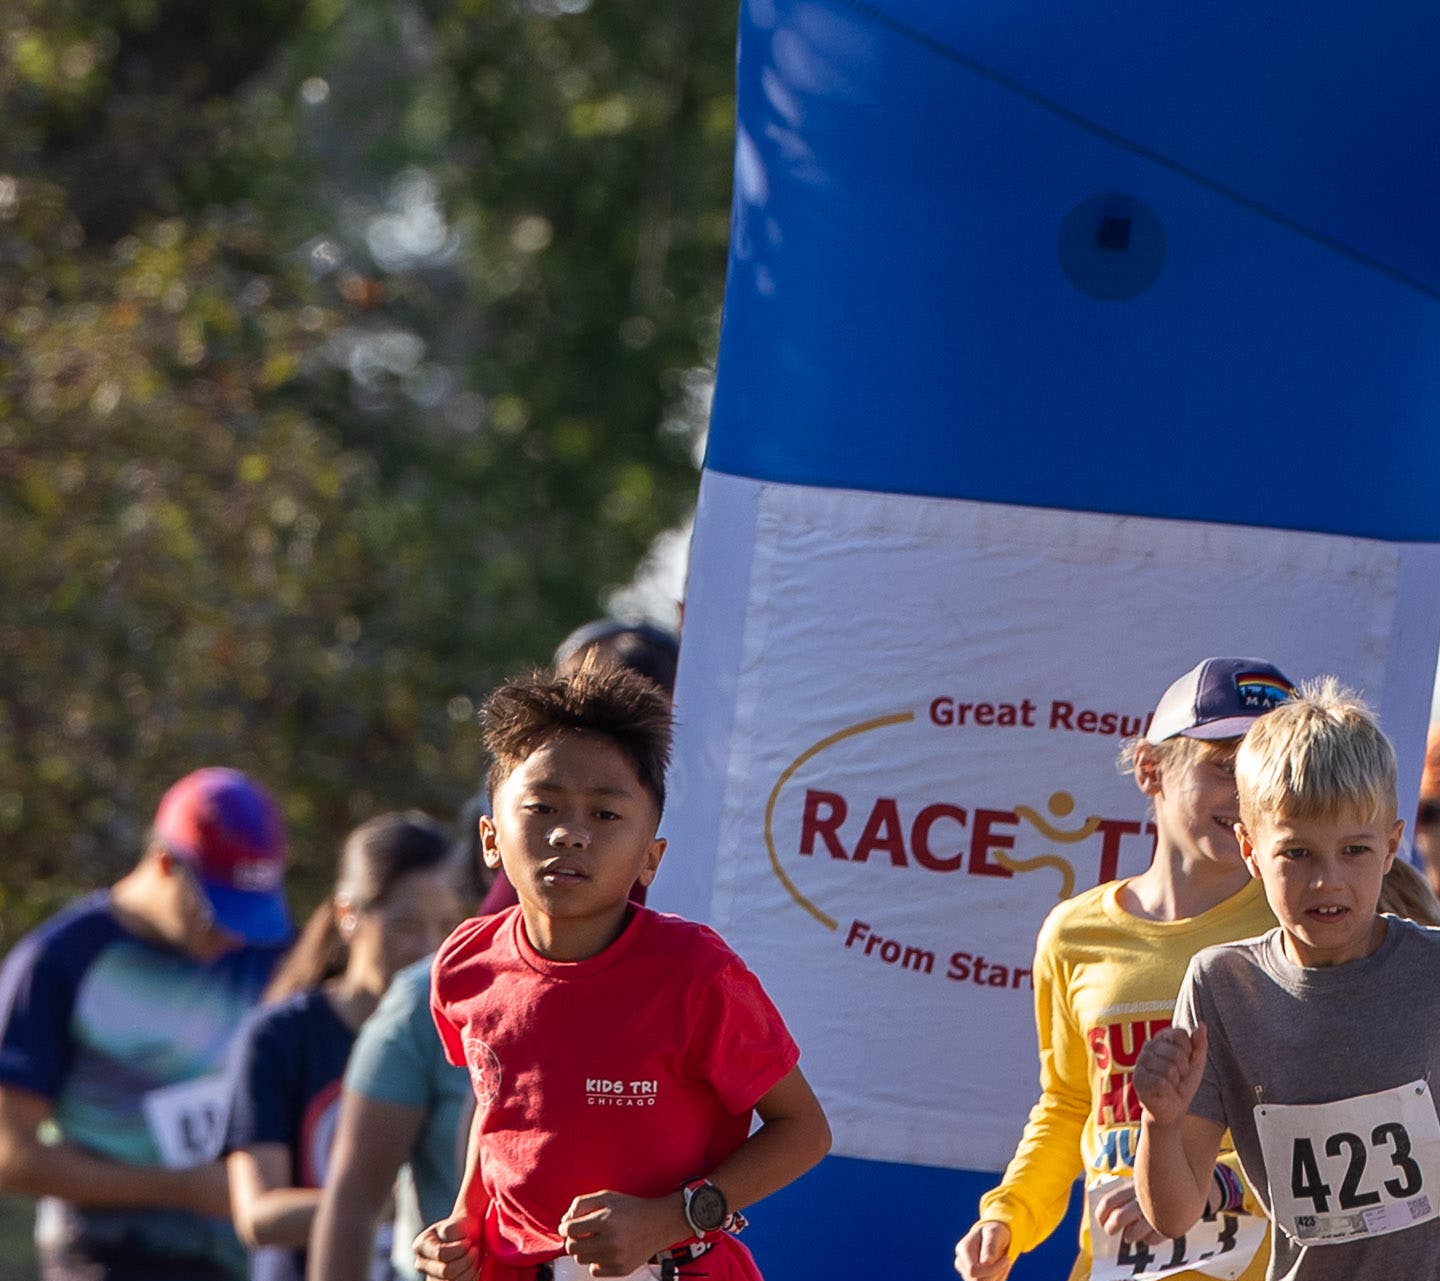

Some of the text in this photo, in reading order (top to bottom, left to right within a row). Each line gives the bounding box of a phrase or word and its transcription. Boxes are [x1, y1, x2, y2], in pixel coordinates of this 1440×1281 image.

[929, 696, 1155, 738] Great Resul
[799, 789, 1020, 879] RACE
[844, 919, 1034, 991] From Star
[586, 1078, 658, 1094] KIDS TRI
[587, 1097, 655, 1106] CHICAGO
[1291, 1122, 1423, 1214] 423
